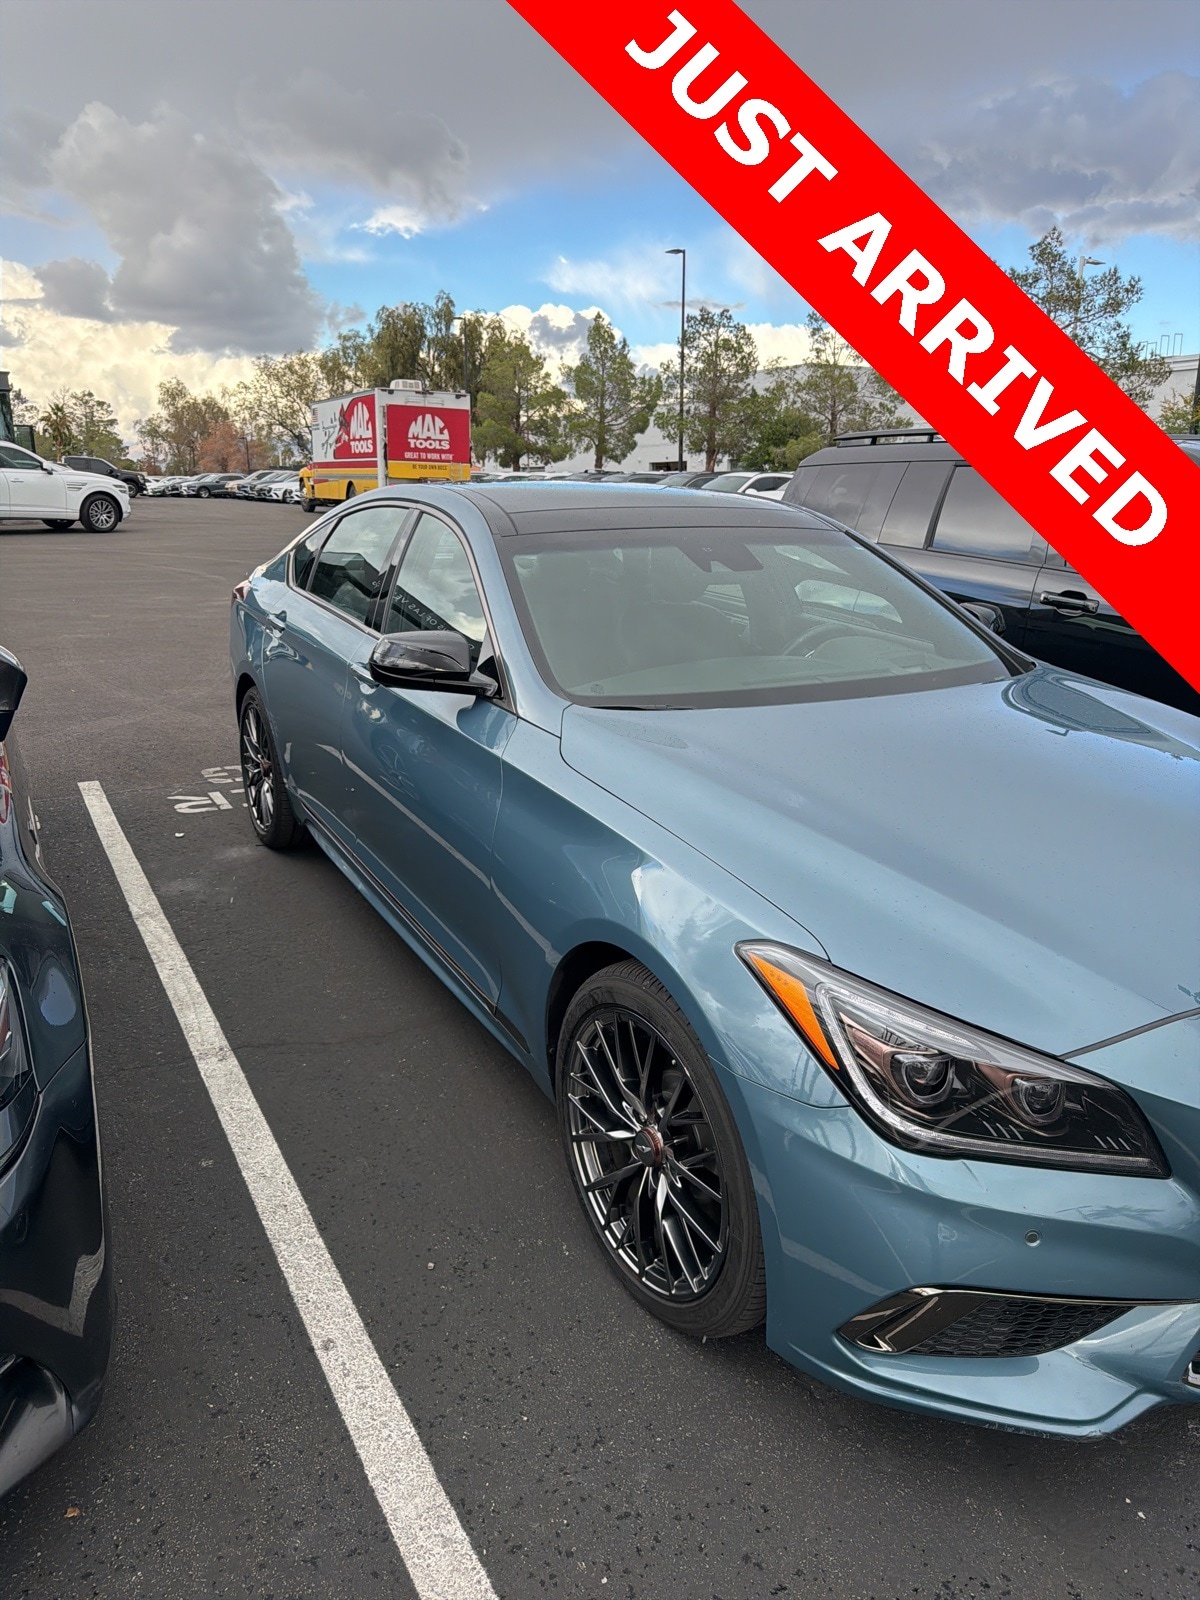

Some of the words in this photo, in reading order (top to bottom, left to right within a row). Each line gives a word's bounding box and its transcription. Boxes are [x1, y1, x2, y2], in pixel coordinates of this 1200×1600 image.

[350, 402, 372, 439] MAC
[408, 413, 450, 440] MAC
[350, 439, 373, 454] TOOLS
[407, 438, 450, 450] TOOLS
